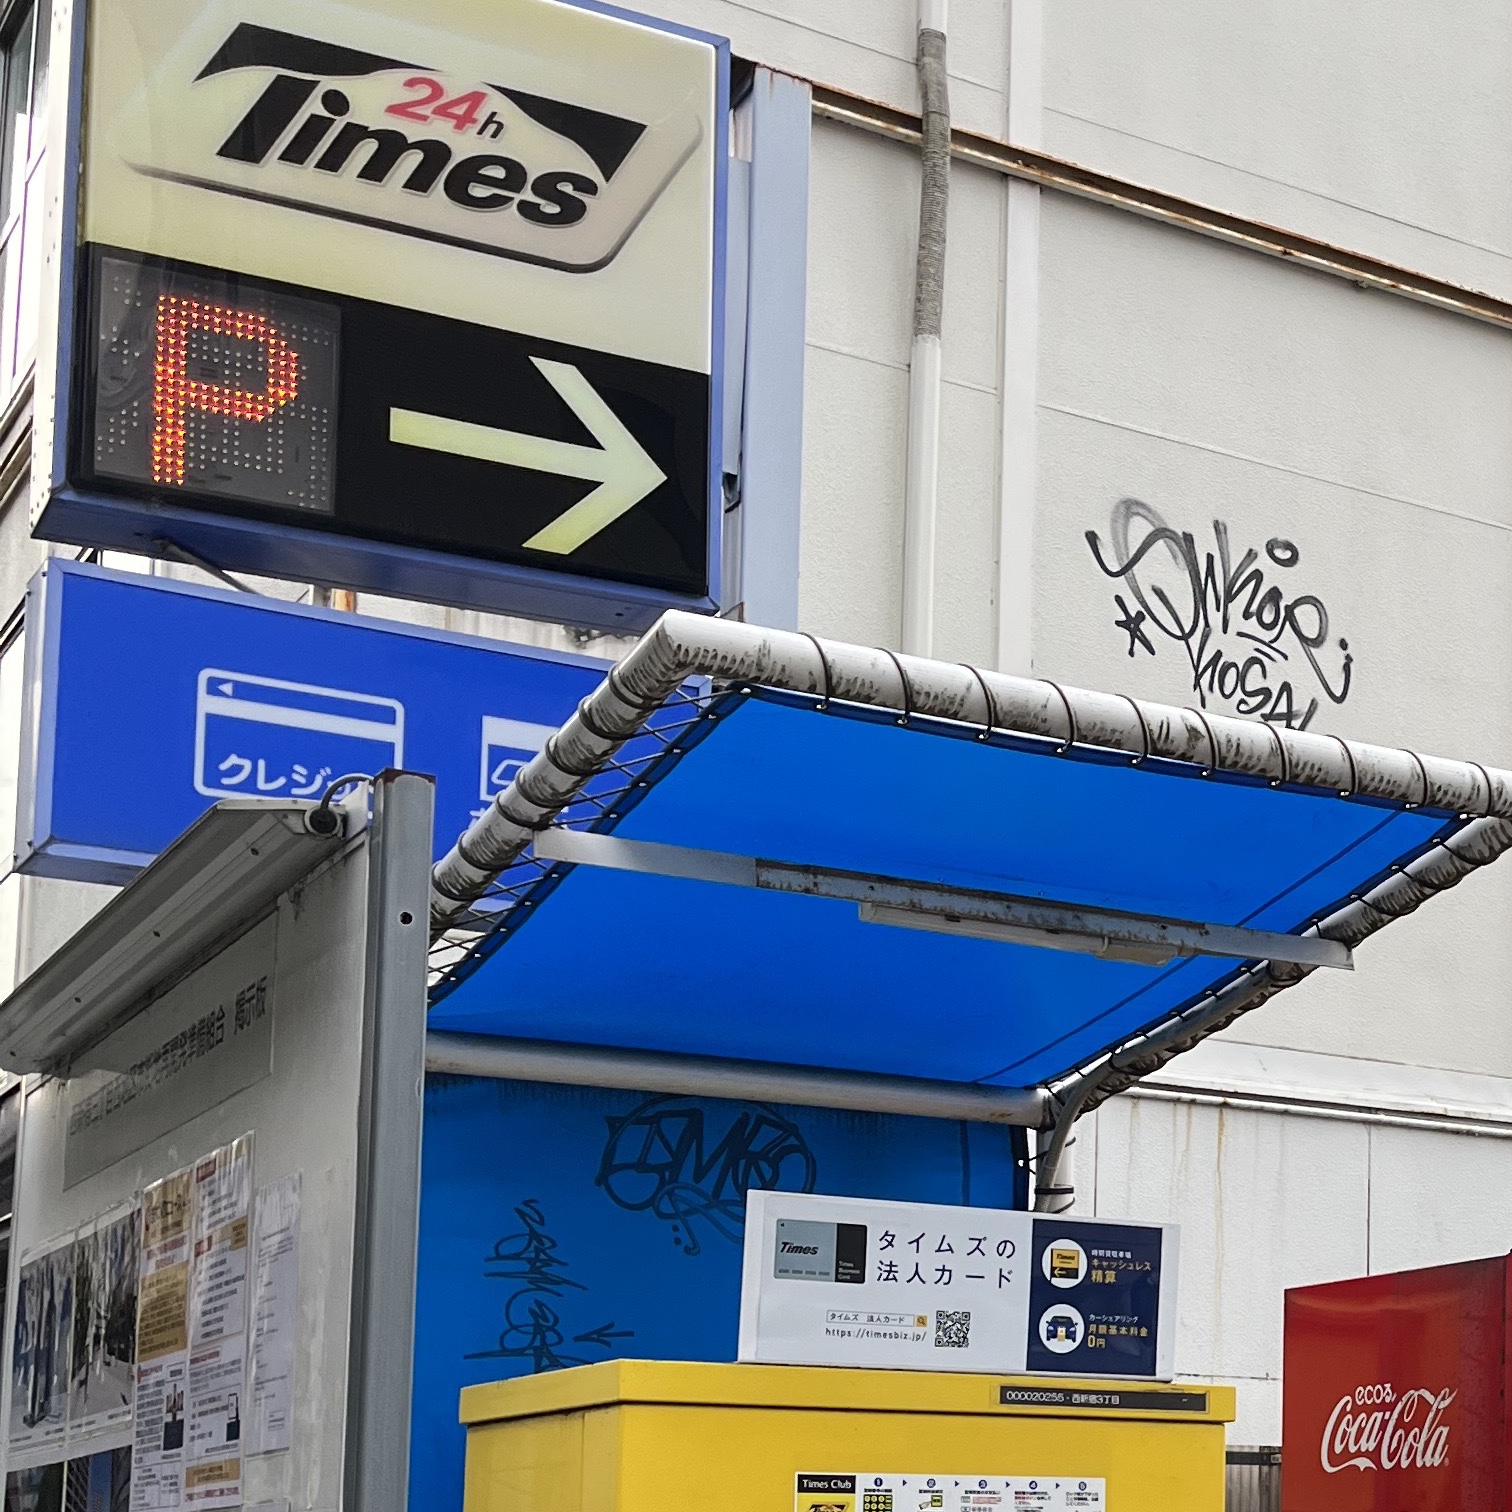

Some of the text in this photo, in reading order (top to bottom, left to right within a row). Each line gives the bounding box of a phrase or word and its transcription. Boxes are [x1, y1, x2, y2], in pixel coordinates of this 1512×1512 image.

[384, 75, 505, 139] 24h
[215, 73, 600, 227] Times
[153, 293, 299, 486] P
[780, 1241, 819, 1255] Times
[879, 1230, 1016, 1258] タイムズの
[1092, 1259, 1151, 1270] キャッシュレス
[876, 1260, 1013, 1289] 法人カード
[830, 1312, 904, 1324] タイムズ 法人カード
[1089, 1314, 1138, 1323] カーシェアリング
[825, 1328, 927, 1341] https://timesbiz.jp/
[1088, 1335, 1105, 1348] 0円
[1320, 1387, 1459, 1473] Coca-Cola
[802, 1479, 852, 1489] Times Club
